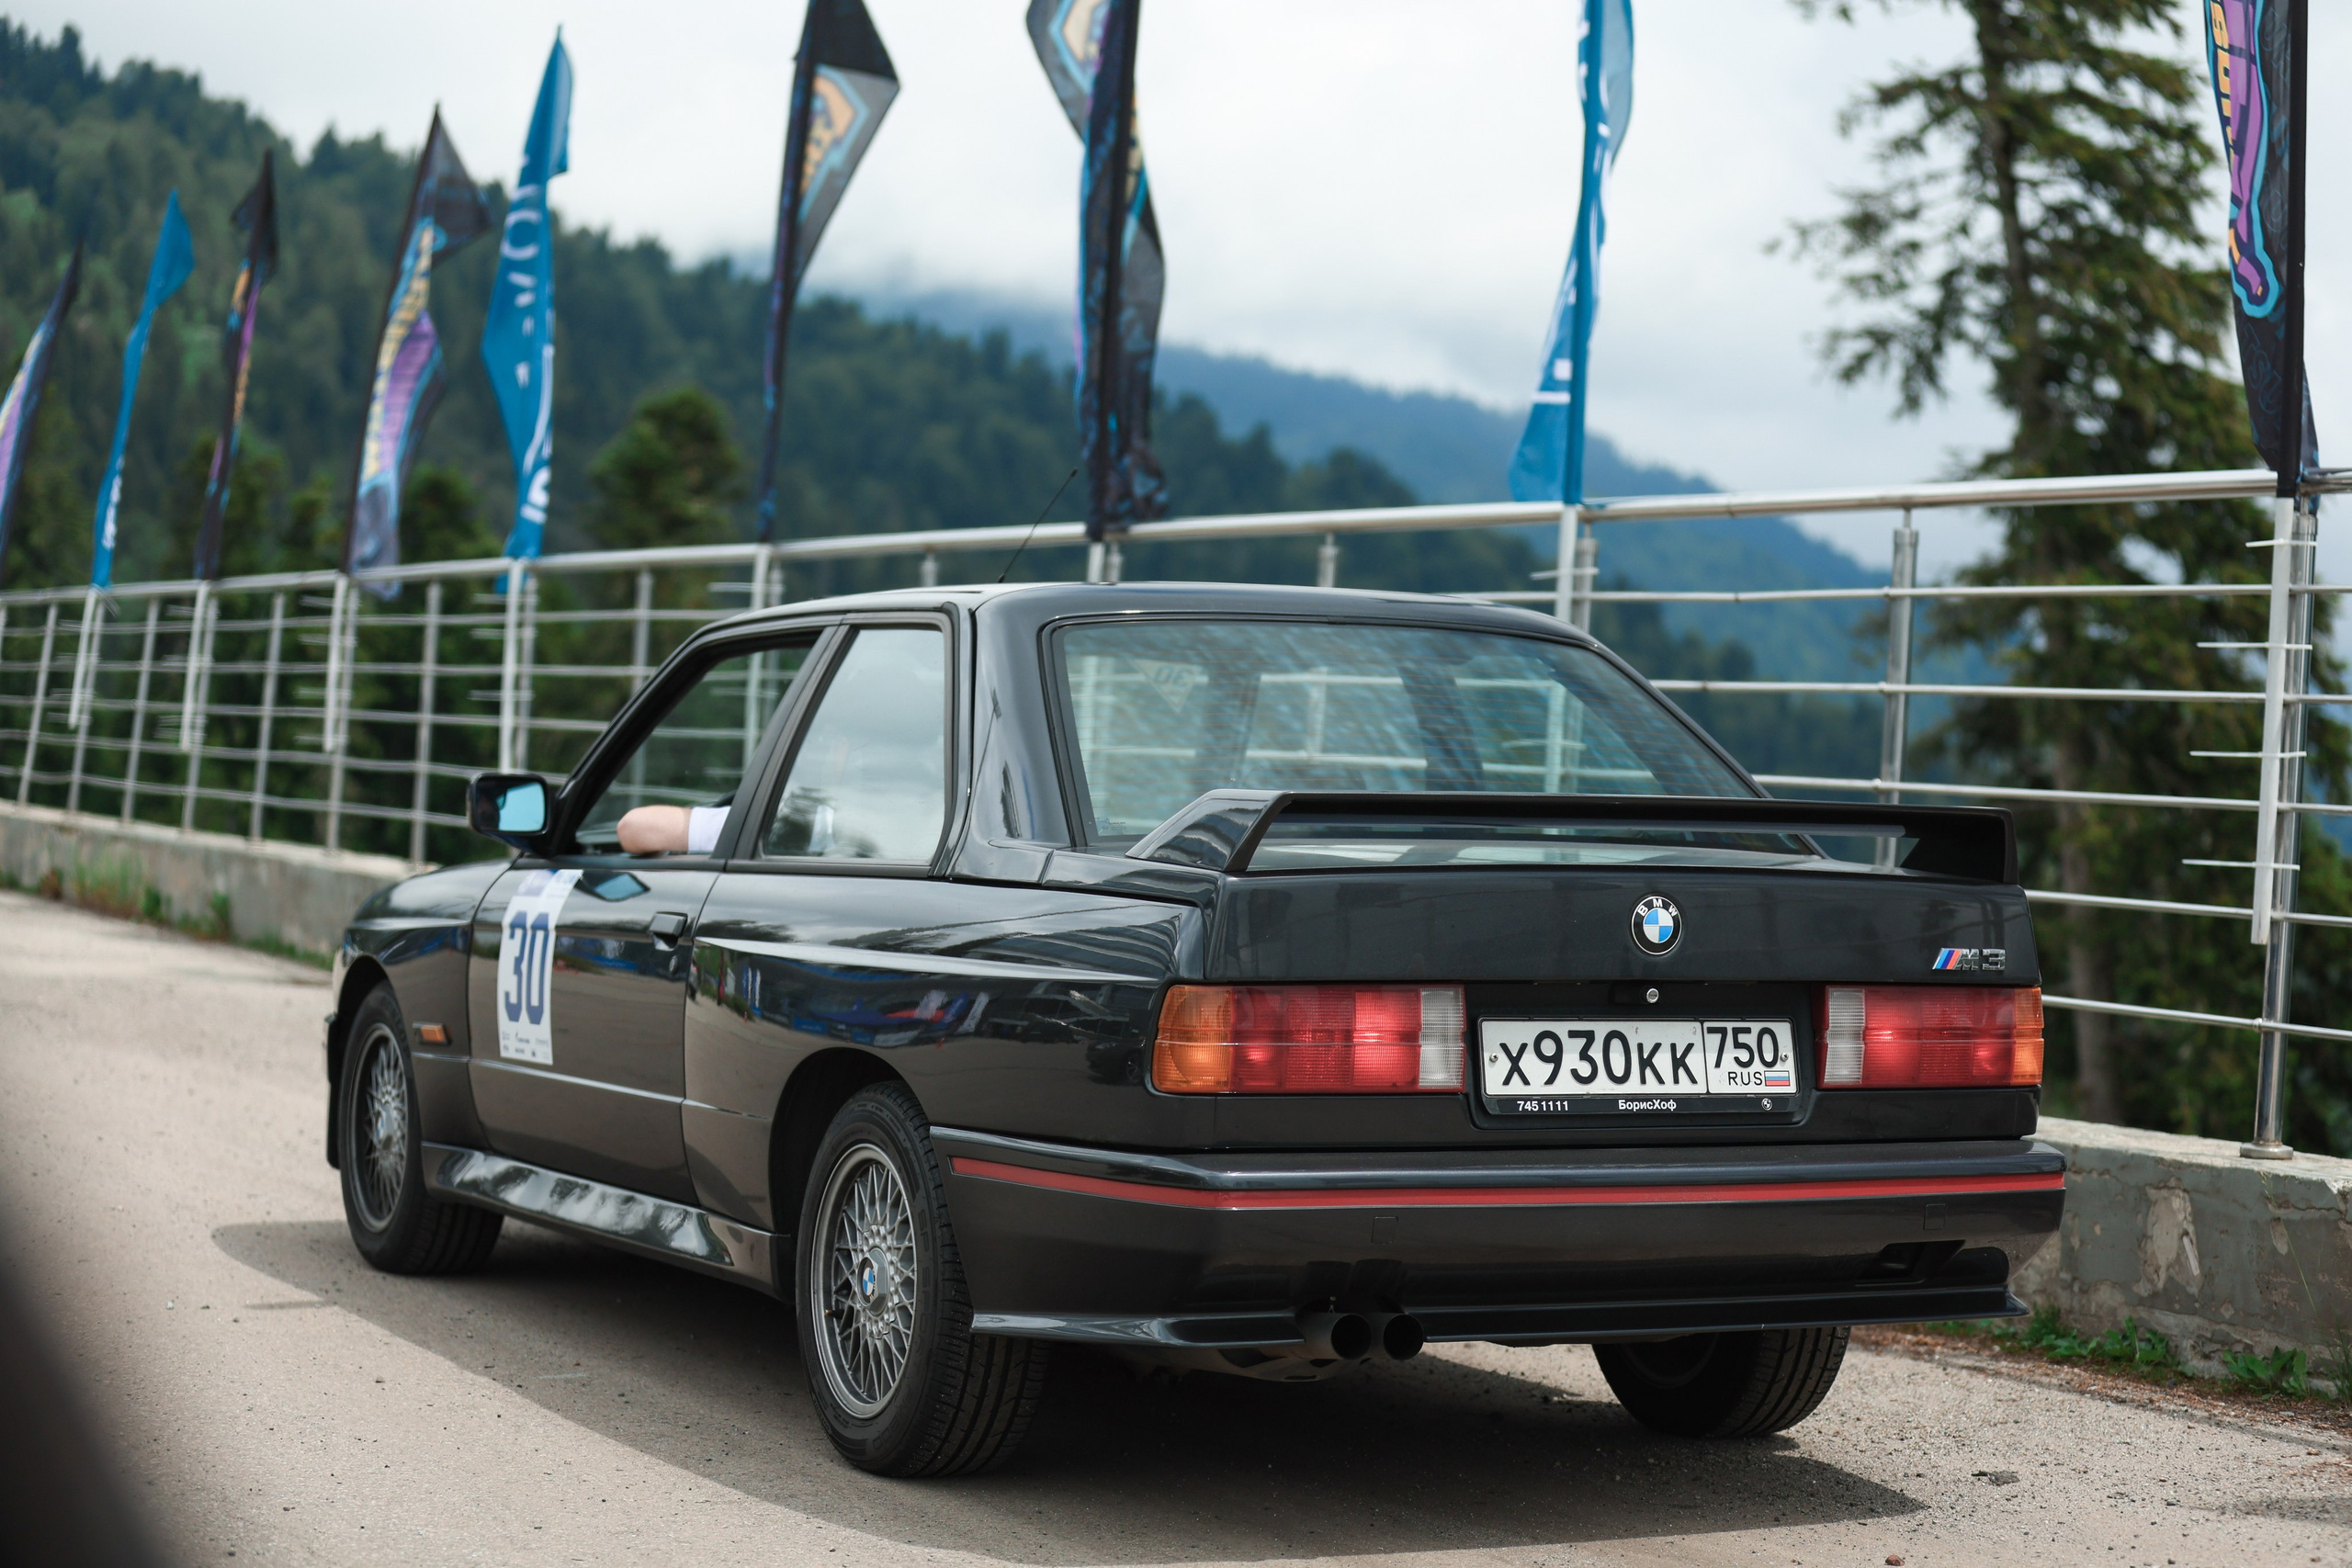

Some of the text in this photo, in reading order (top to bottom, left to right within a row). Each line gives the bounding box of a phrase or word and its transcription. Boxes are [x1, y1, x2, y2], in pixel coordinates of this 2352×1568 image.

[1637, 898, 1678, 917] BMW
[504, 910, 549, 1025] 30
[1706, 1027, 1780, 1068] 750
[1728, 1071, 1763, 1087] RUS
[1618, 1099, 1677, 1112] БорисХоф
